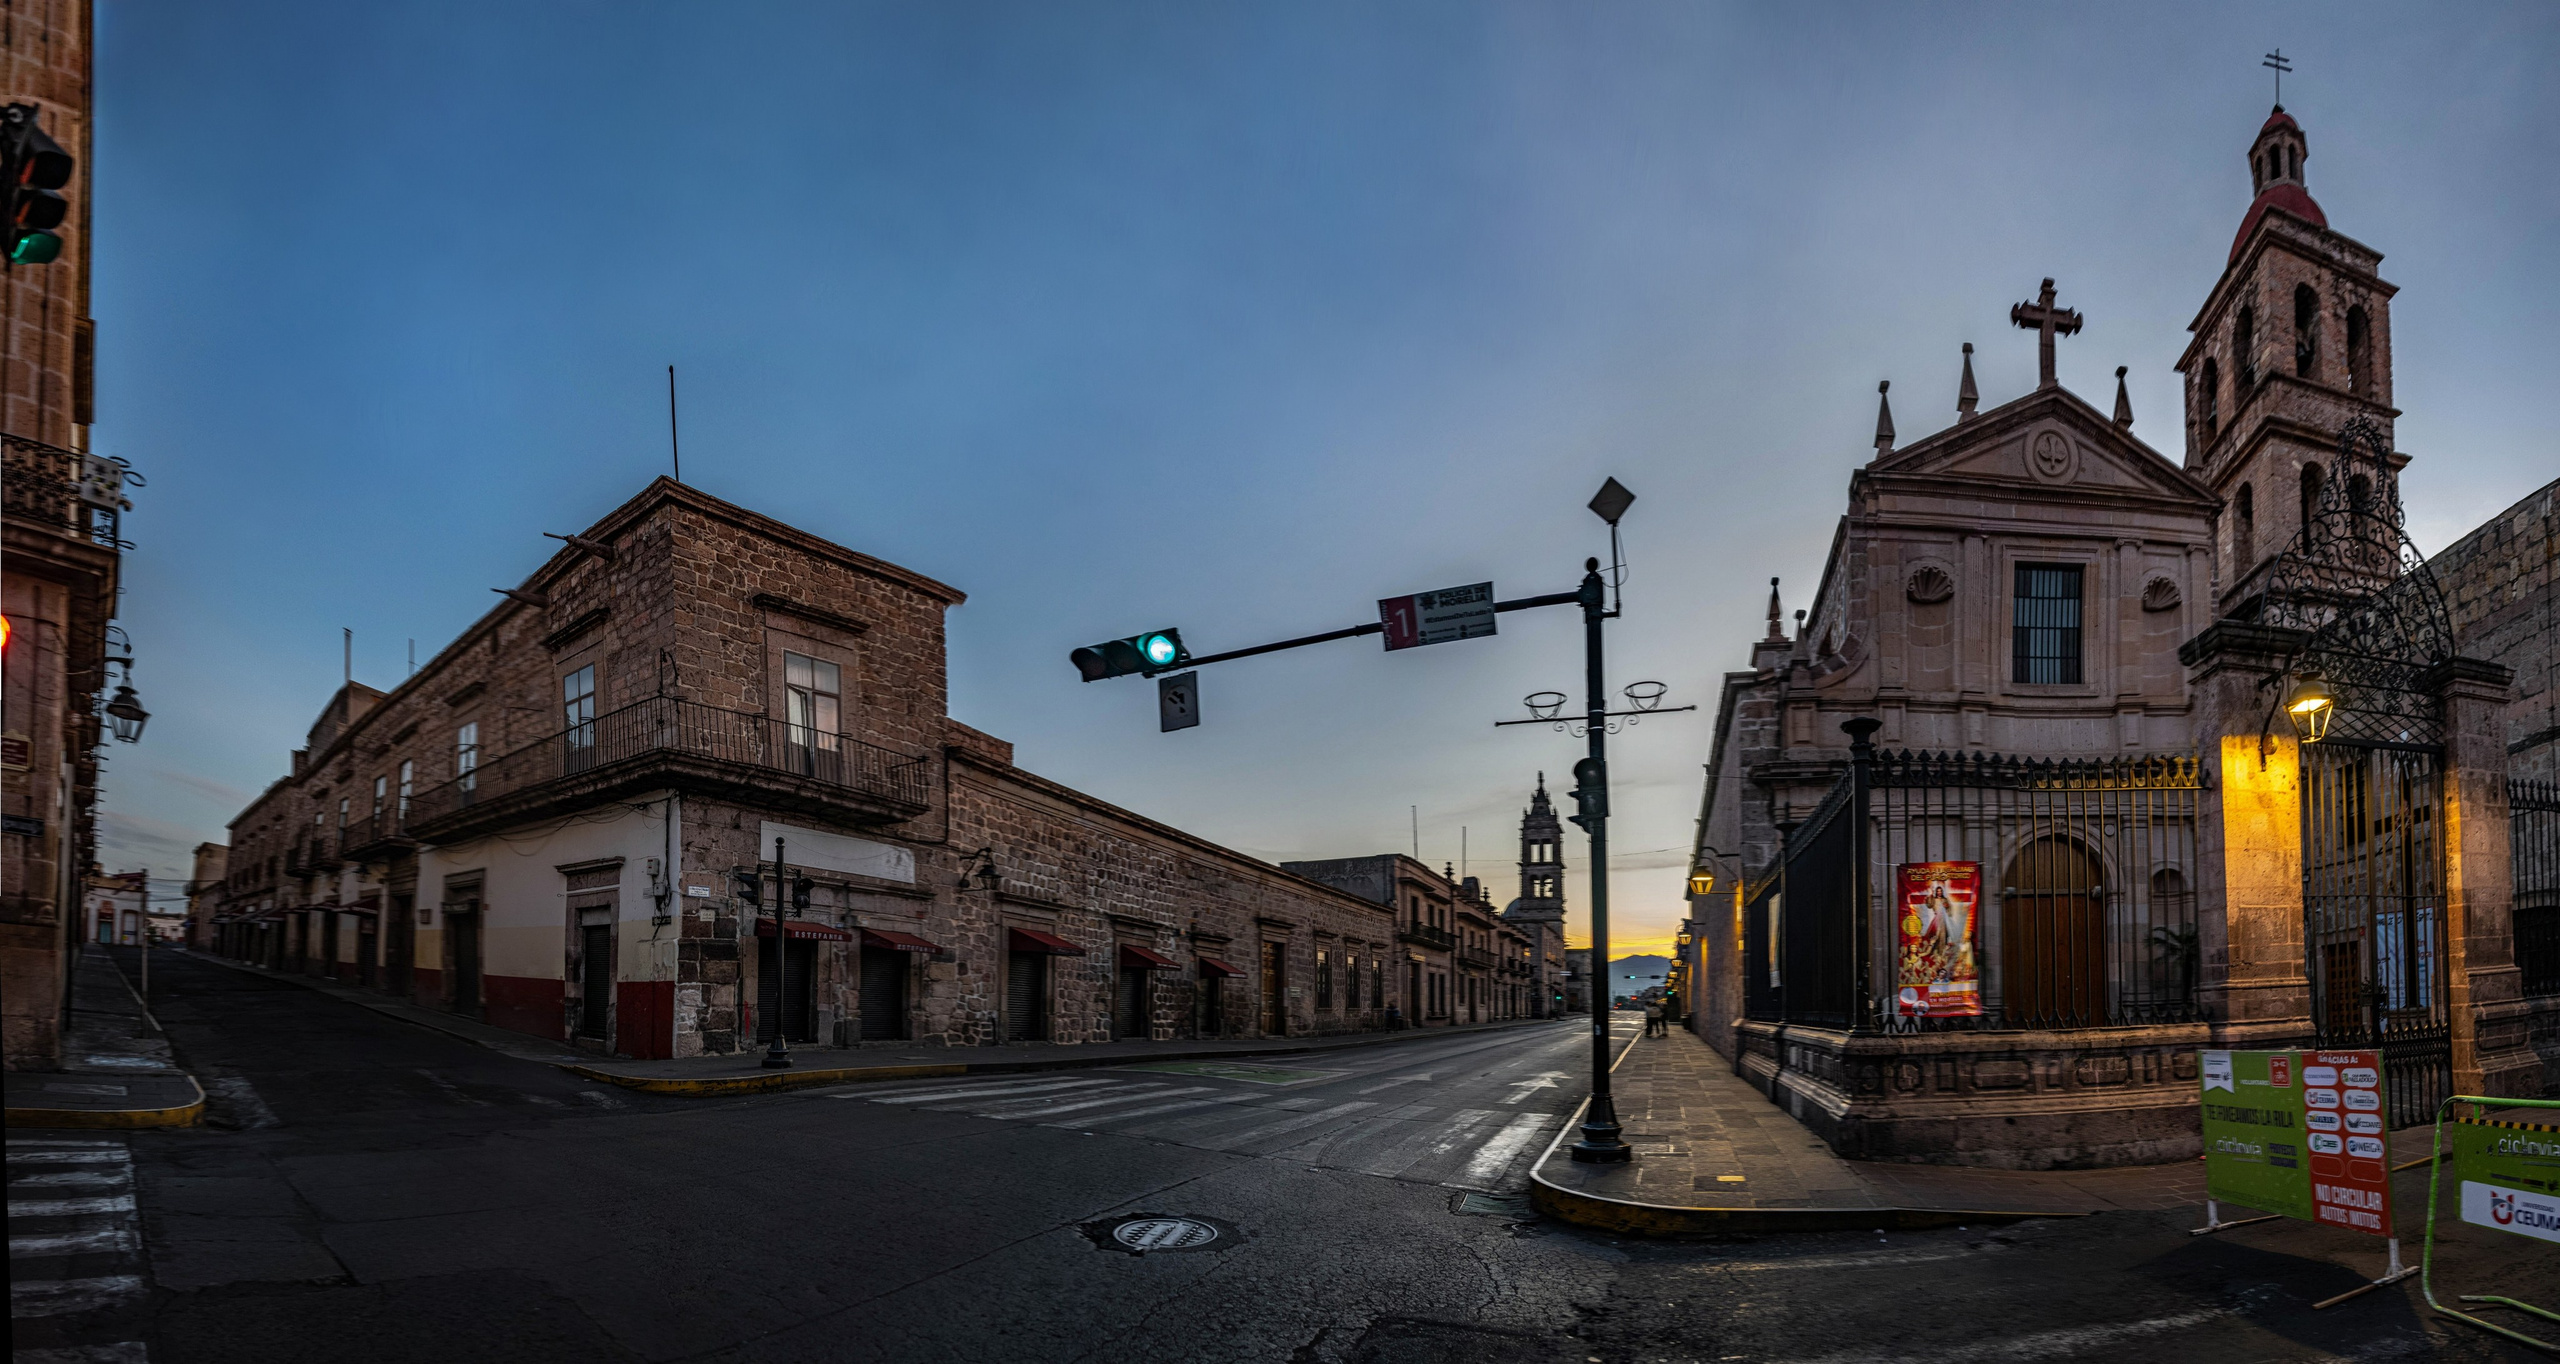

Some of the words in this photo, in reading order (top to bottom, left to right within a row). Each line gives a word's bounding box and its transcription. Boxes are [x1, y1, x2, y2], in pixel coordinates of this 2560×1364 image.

[1439, 594, 1488, 608] MORELIA
[1395, 608, 1408, 637] 1
[2317, 1056, 2349, 1064] GRACIAS
[2350, 1055, 2359, 1064] A:
[2315, 1183, 2330, 1202] NO
[2331, 1186, 2383, 1211] CIRCULAR
[2320, 1205, 2348, 1223] AUTOS
[2349, 1210, 2381, 1229] MOTOS
